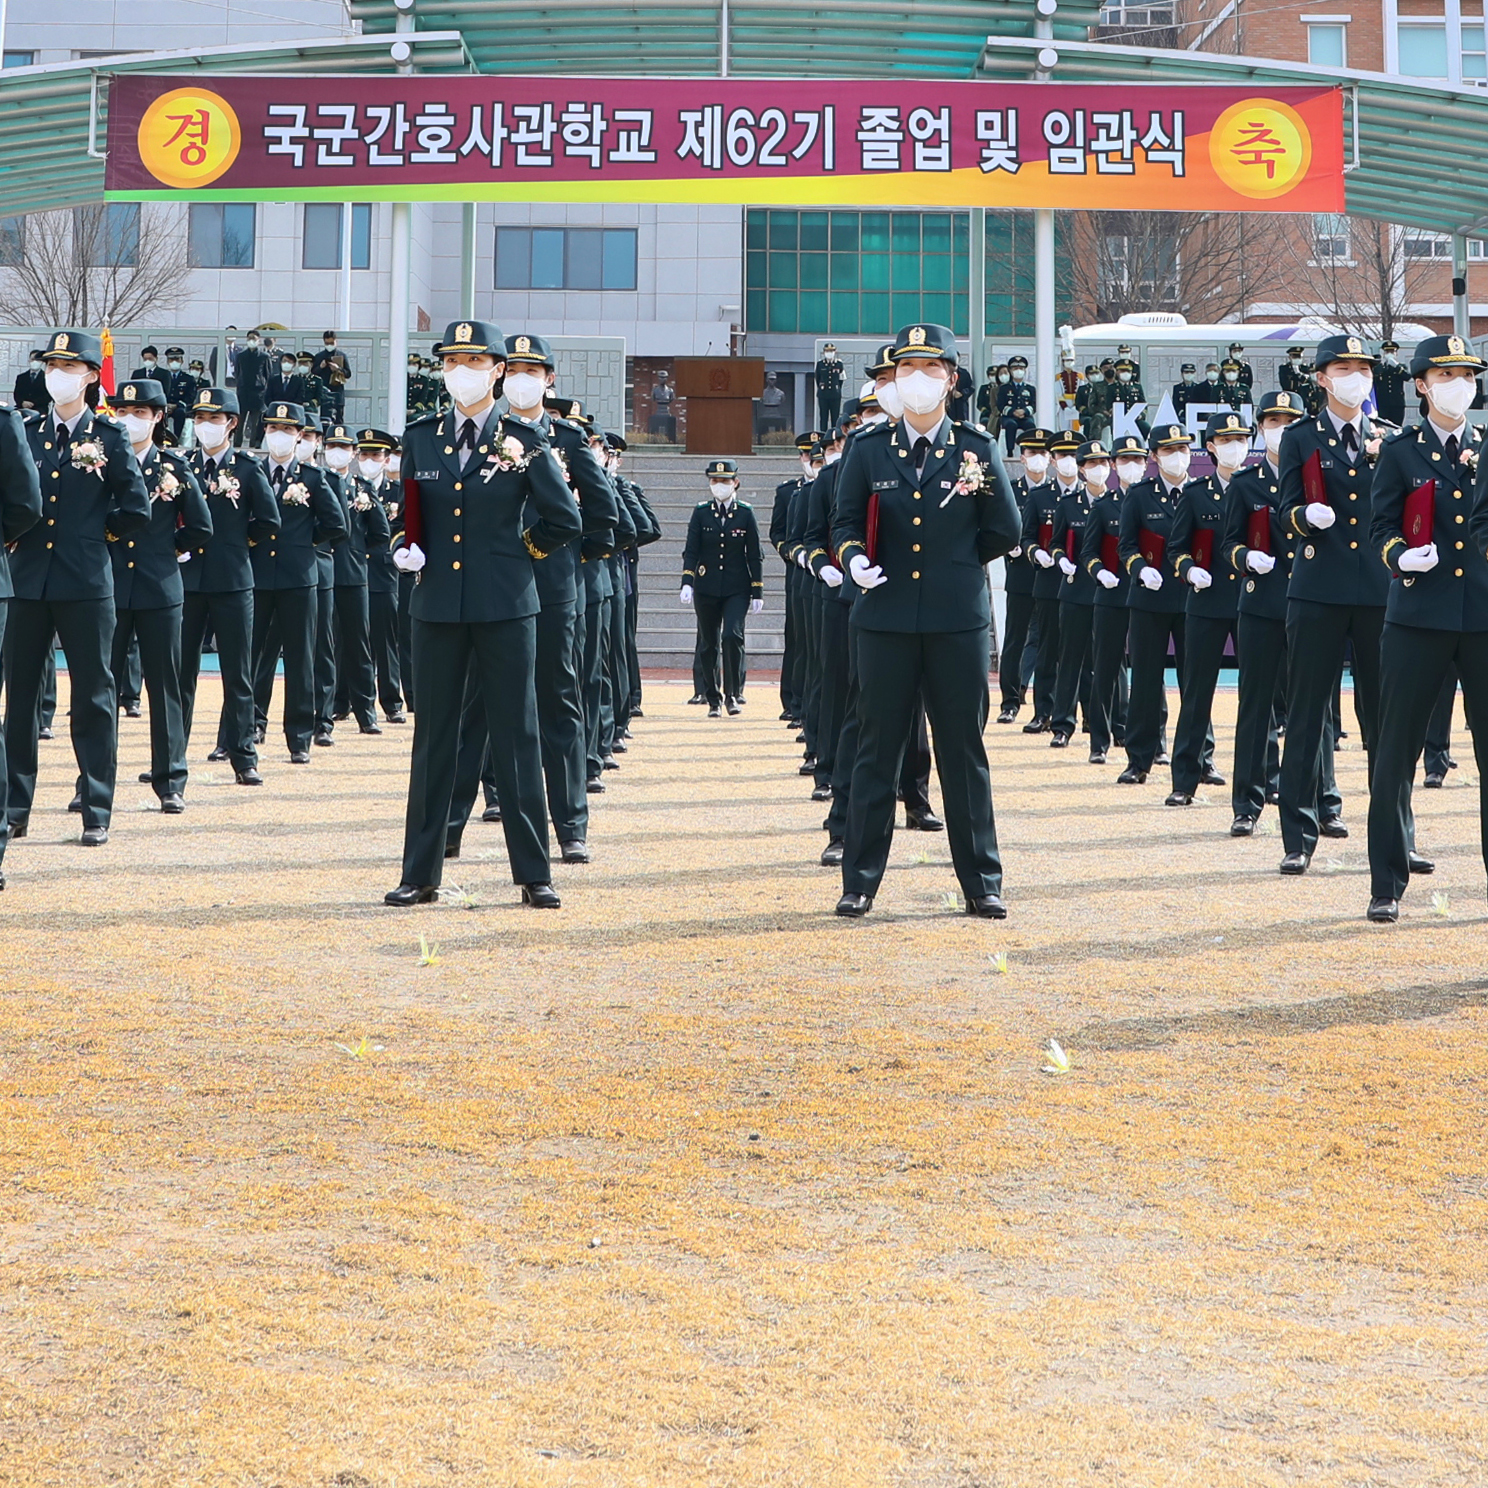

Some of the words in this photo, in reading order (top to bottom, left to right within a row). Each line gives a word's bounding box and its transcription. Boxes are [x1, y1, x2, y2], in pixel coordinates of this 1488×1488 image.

[162, 108, 211, 166] 경
[262, 101, 657, 169] 국군간호사관학교
[677, 104, 836, 171] 제62기
[856, 105, 952, 172] 졸업
[974, 107, 1024, 175] 및
[1042, 108, 1187, 177] 임관식
[1229, 121, 1287, 180] 축
